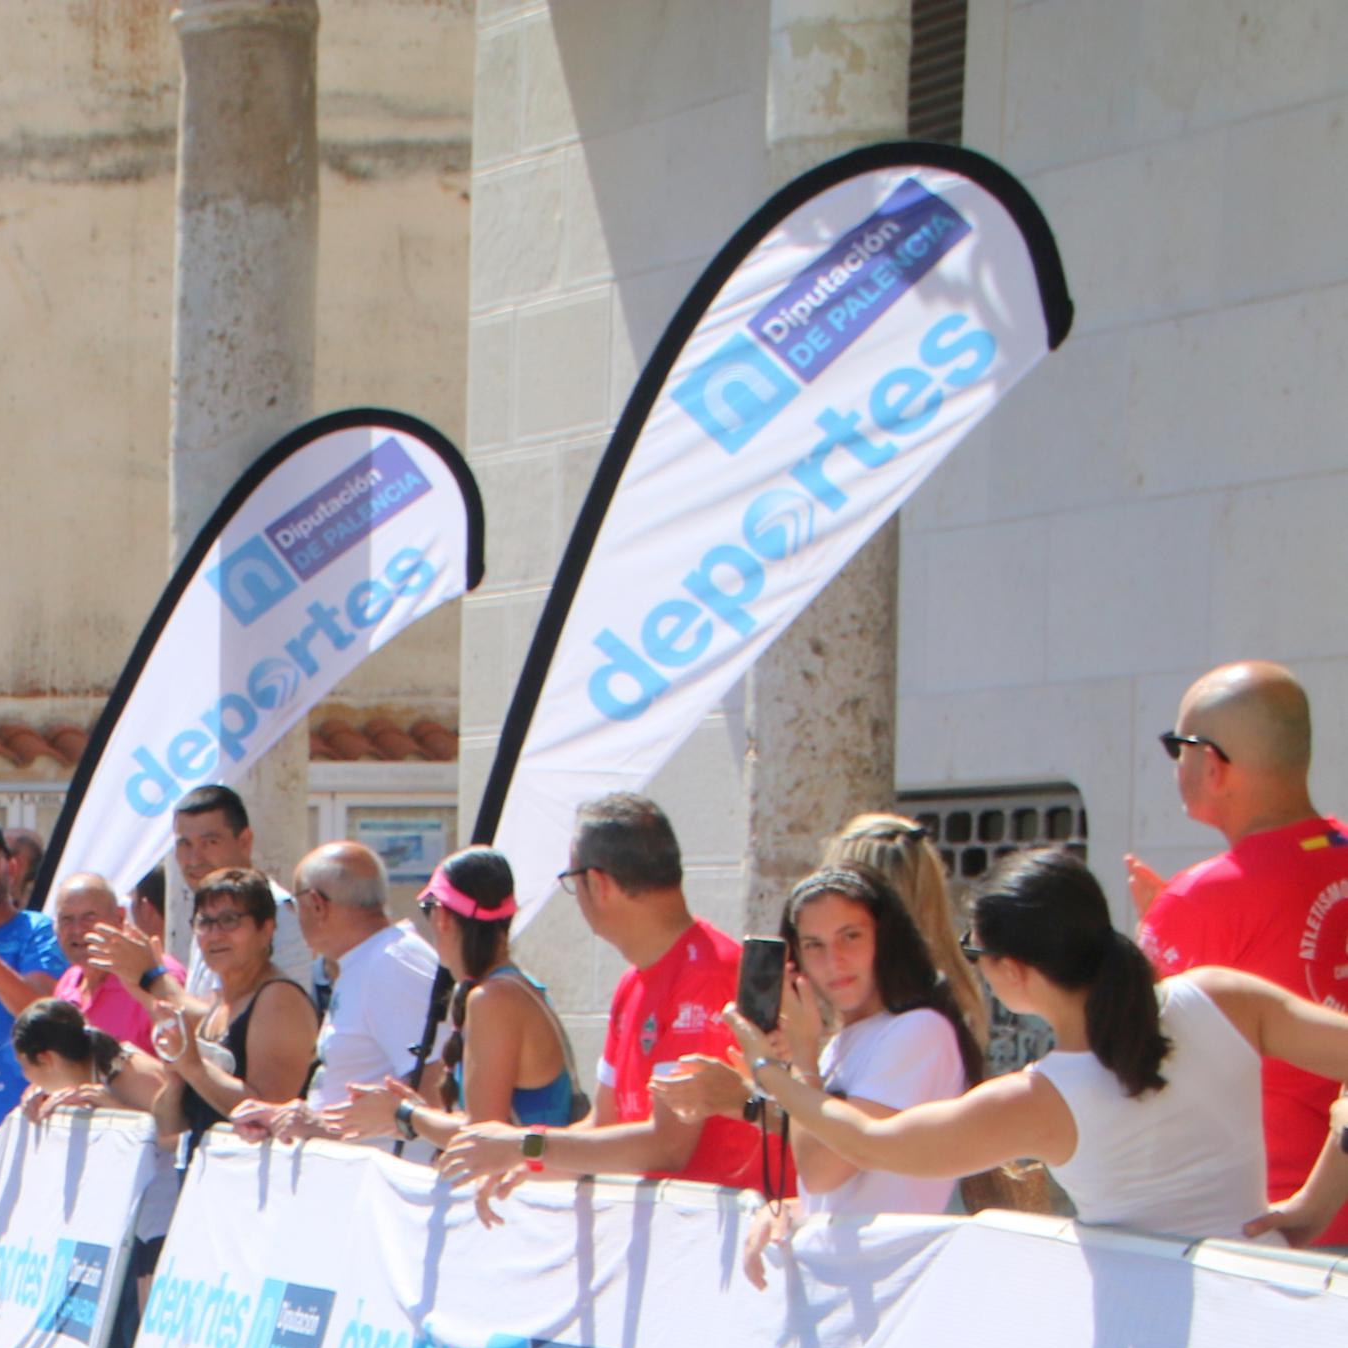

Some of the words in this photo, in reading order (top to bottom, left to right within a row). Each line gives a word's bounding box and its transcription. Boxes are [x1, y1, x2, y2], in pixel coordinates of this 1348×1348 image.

[761, 220, 902, 345] Diputación
[787, 325, 833, 369] DE
[825, 214, 957, 333] PALENCIA
[274, 467, 384, 549] Diputación
[292, 540, 323, 571] DE
[322, 471, 424, 548] PALENCIA
[586, 311, 998, 723] deportes
[123, 544, 438, 819] deportes
